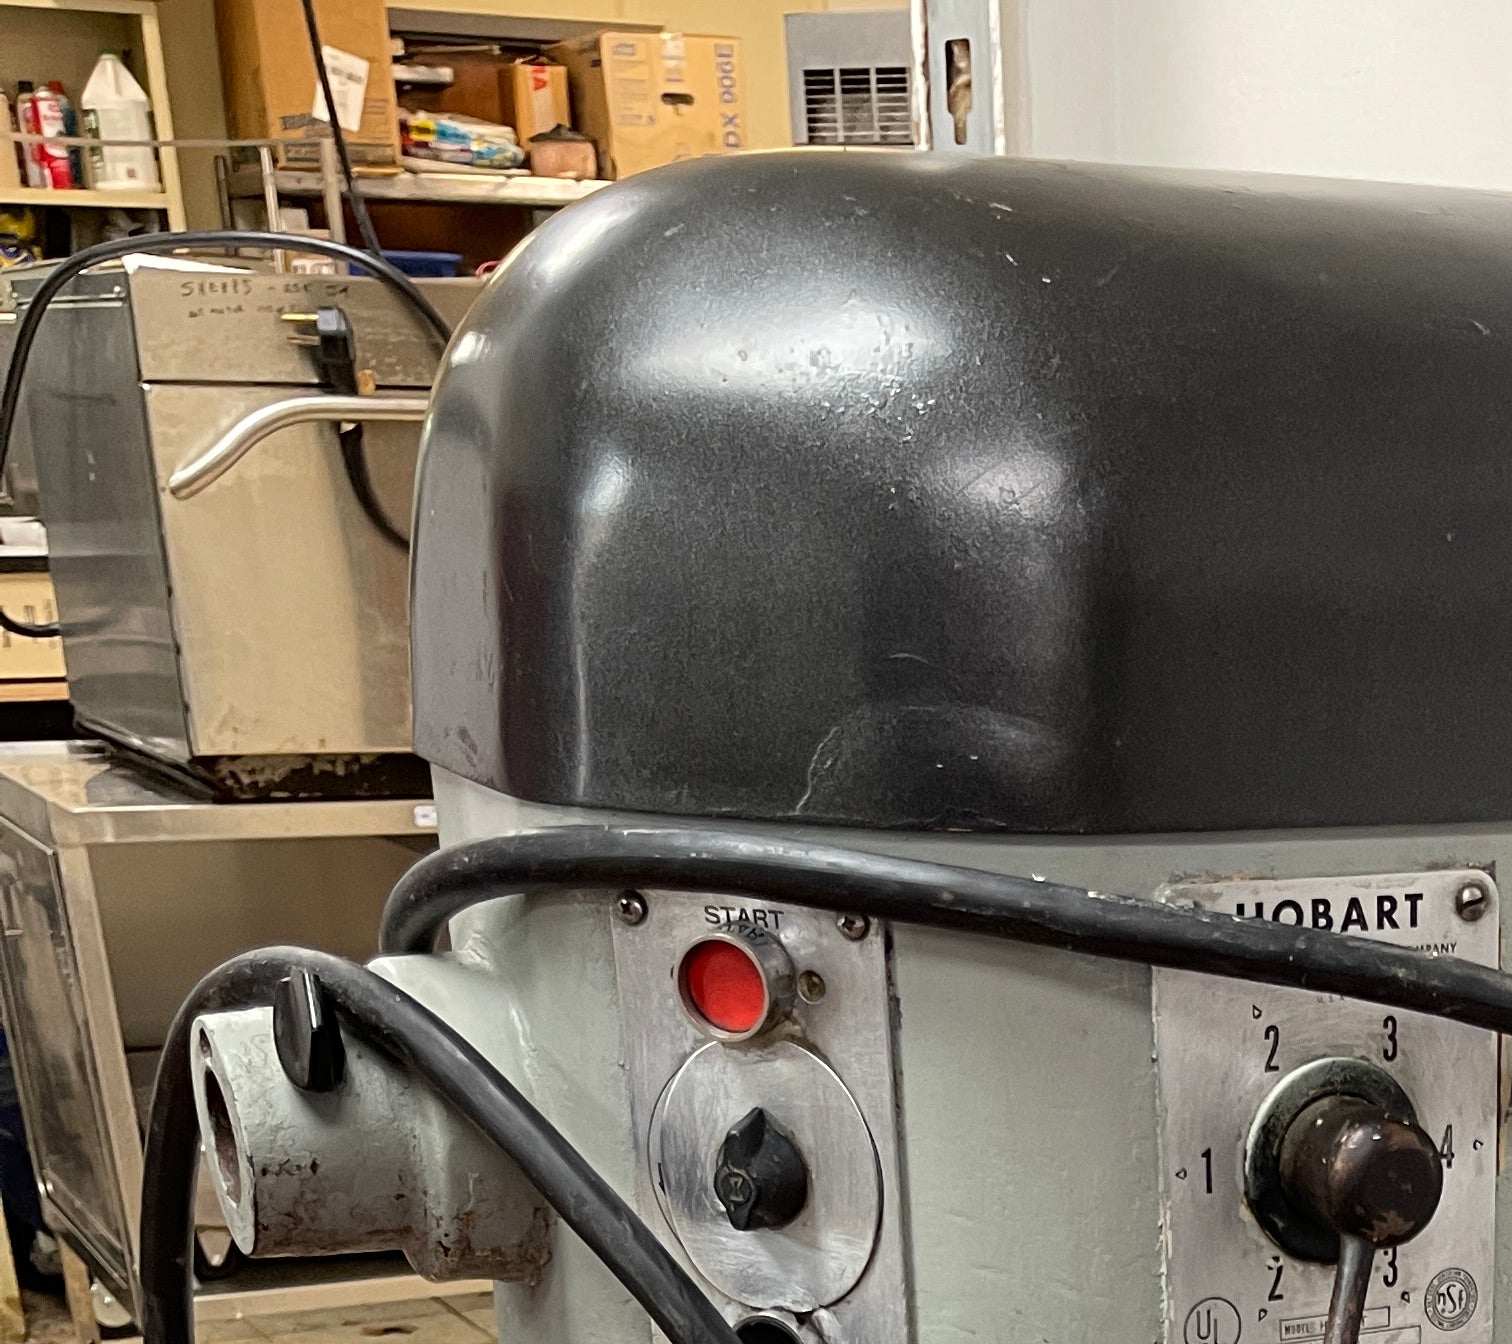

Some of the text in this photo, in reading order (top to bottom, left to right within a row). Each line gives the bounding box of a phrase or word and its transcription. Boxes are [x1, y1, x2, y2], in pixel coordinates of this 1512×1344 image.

[704, 905, 784, 929] START
[1264, 1025, 1280, 1073] 2
[1383, 1015, 1398, 1062] 3
[1439, 1123, 1455, 1169] 4
[1202, 1148, 1213, 1195] 1
[1267, 1256, 1284, 1302] 2
[1383, 1245, 1398, 1288] 3
